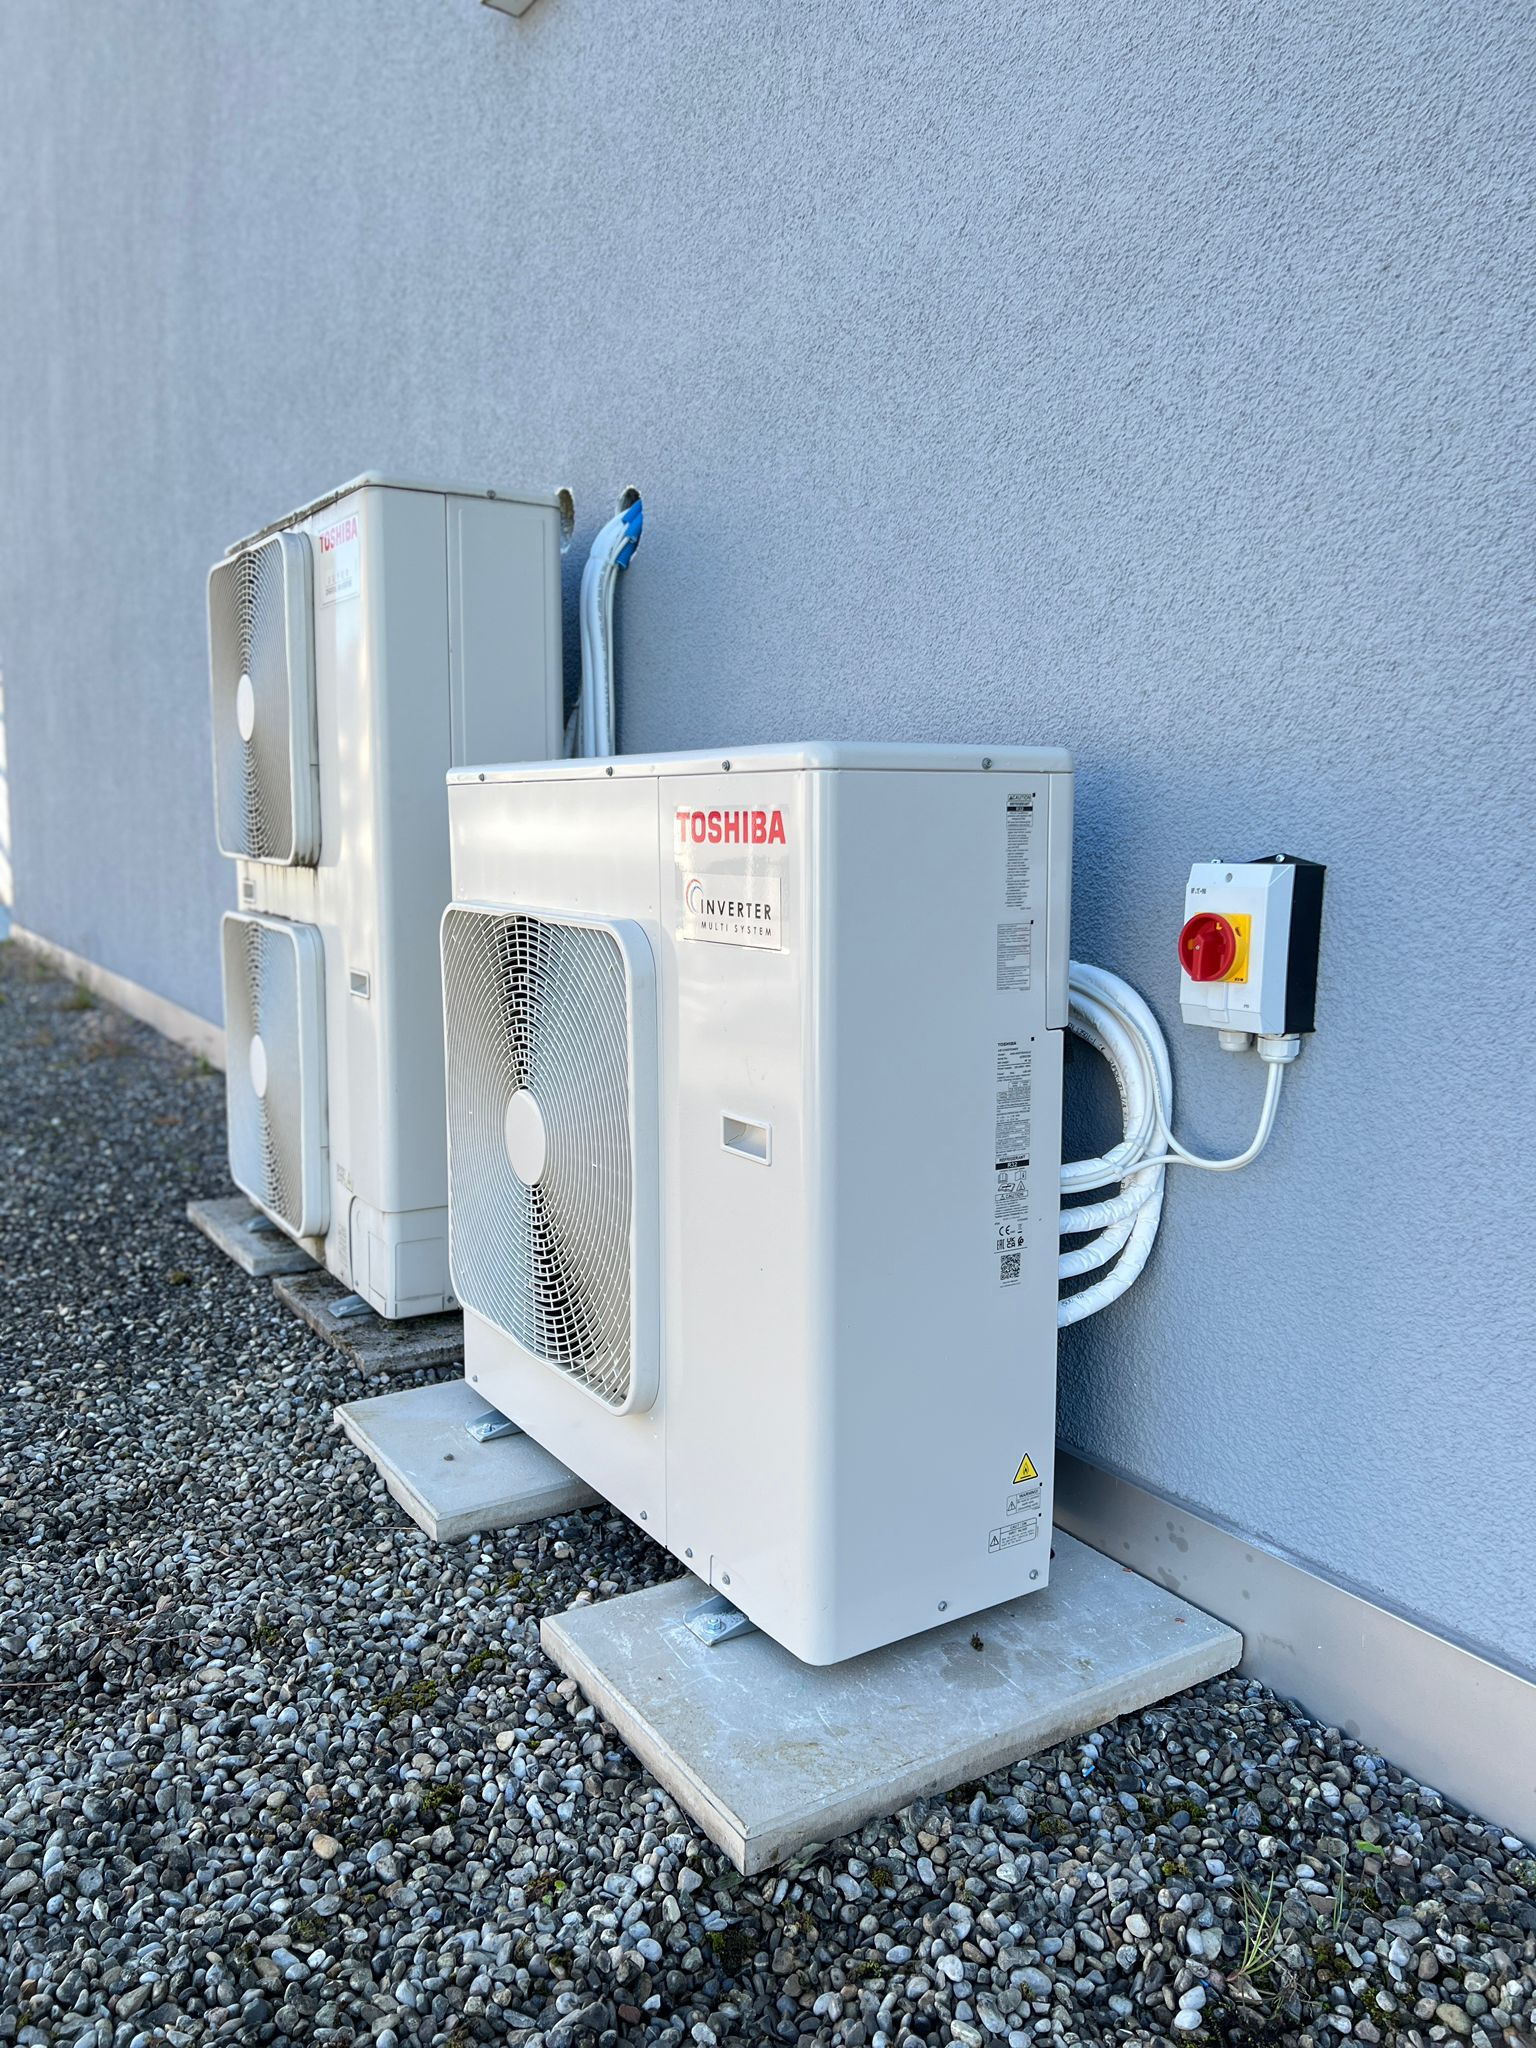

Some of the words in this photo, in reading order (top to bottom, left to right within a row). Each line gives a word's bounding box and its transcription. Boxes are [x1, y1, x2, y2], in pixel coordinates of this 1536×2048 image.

[319, 516, 358, 553] TOSHIBA
[676, 810, 786, 845] TOSHIBA
[700, 898, 772, 921] INVERTER
[700, 921, 729, 932] MULTI
[734, 923, 772, 937] SYSTEM
